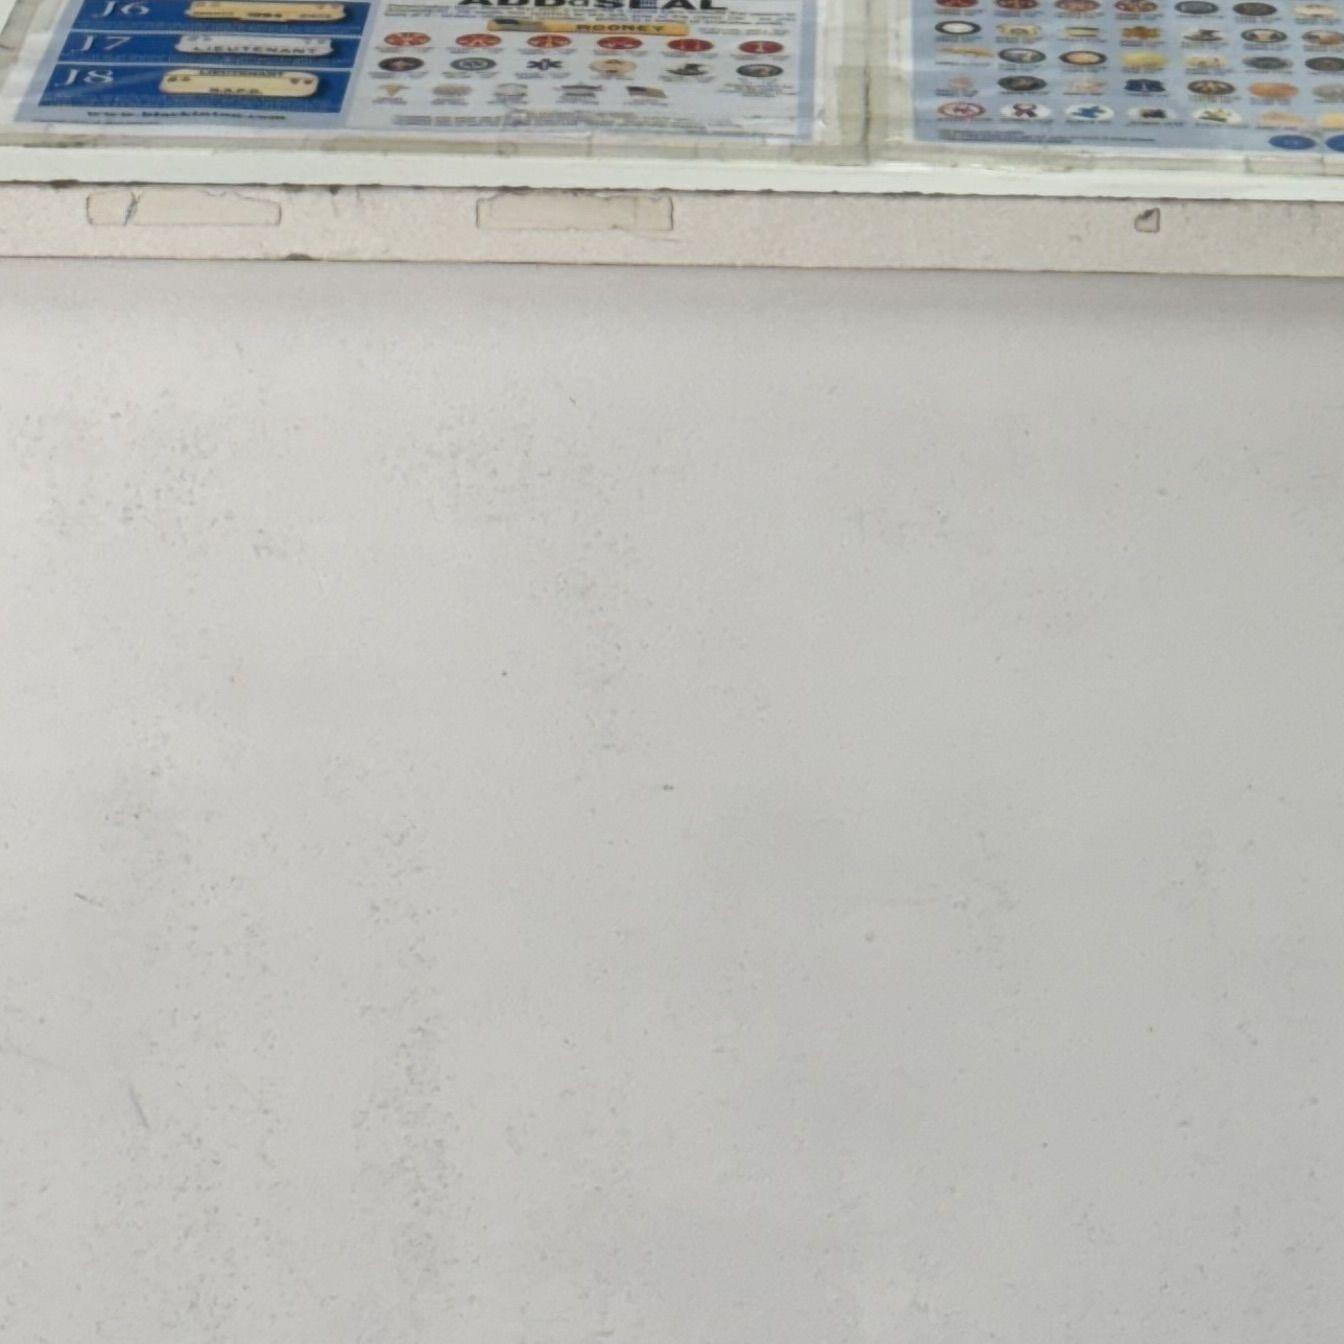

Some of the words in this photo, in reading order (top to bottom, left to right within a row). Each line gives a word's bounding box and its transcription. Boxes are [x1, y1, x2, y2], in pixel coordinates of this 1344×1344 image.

[93, 0, 150, 18] J6
[71, 35, 133, 52] J7
[193, 45, 318, 55] LIEUTENANT
[55, 68, 115, 87] J8
